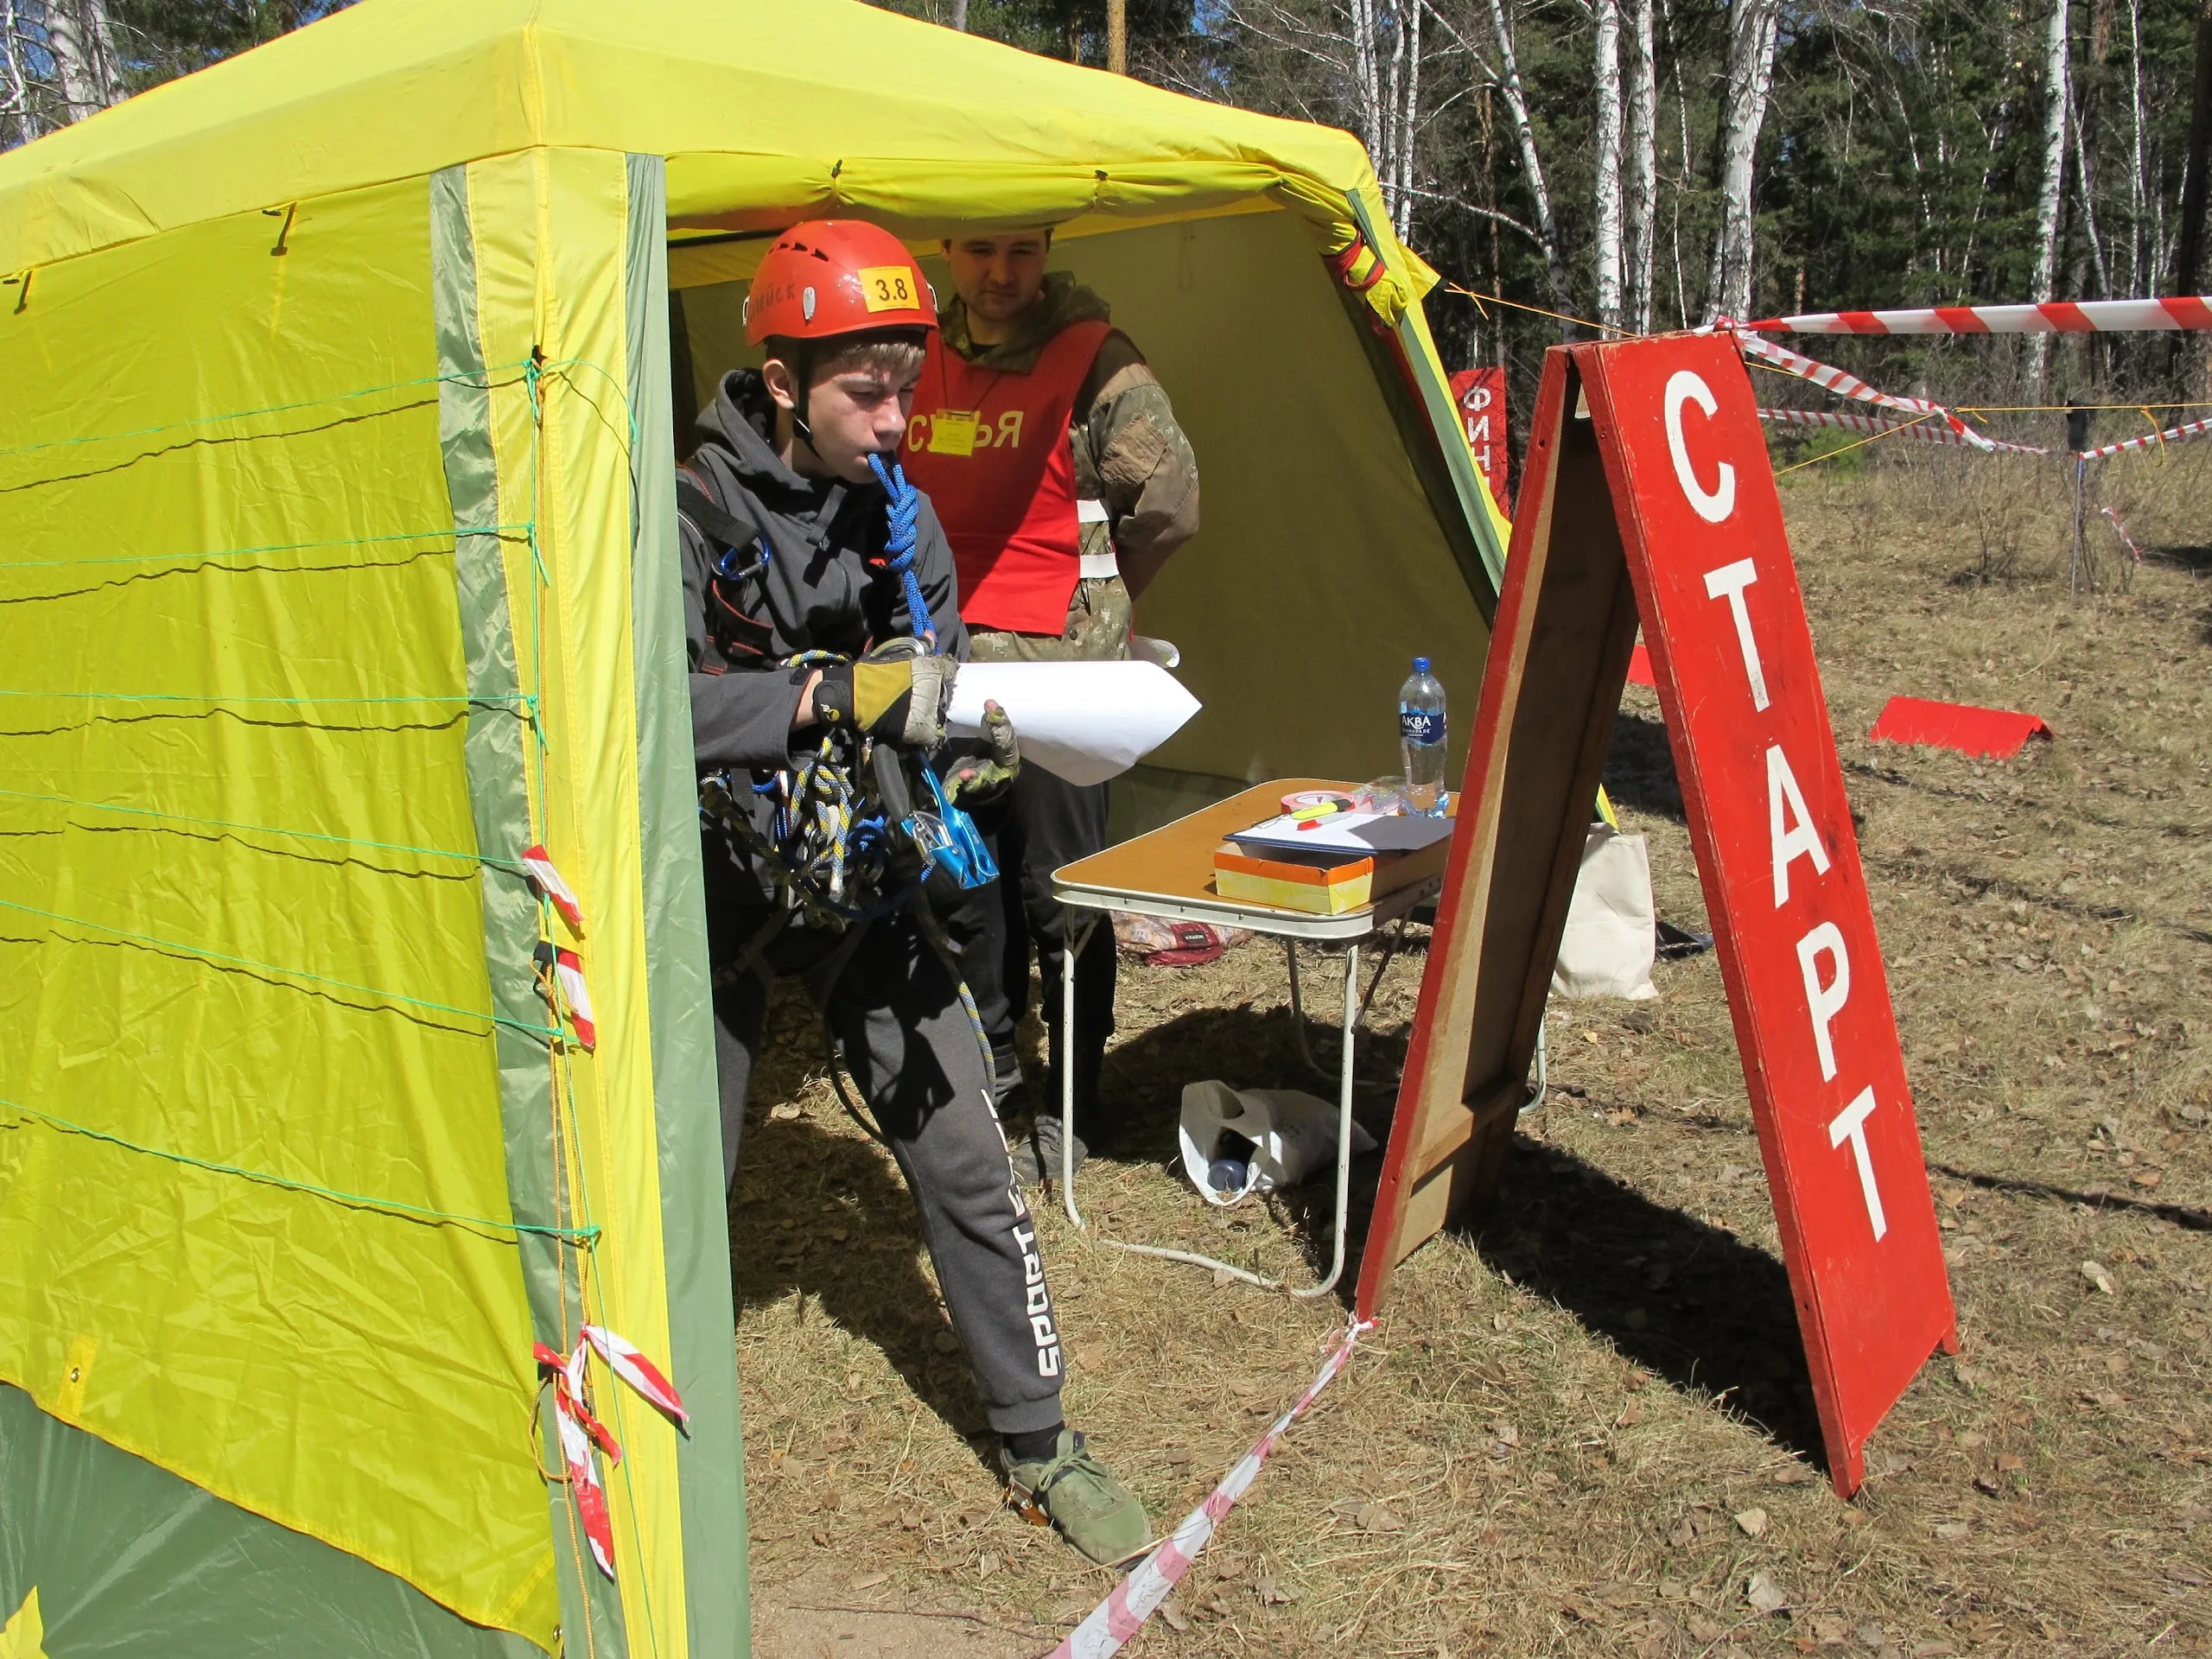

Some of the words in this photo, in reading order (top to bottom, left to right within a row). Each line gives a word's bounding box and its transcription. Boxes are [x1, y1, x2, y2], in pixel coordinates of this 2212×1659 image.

[875, 277, 908, 302] 3.8
[907, 410, 1024, 453] СЬЯ
[1463, 385, 1492, 489] ФИН
[1402, 715, 1432, 729] АКВА
[1663, 370, 1887, 1243] СТАРТ
